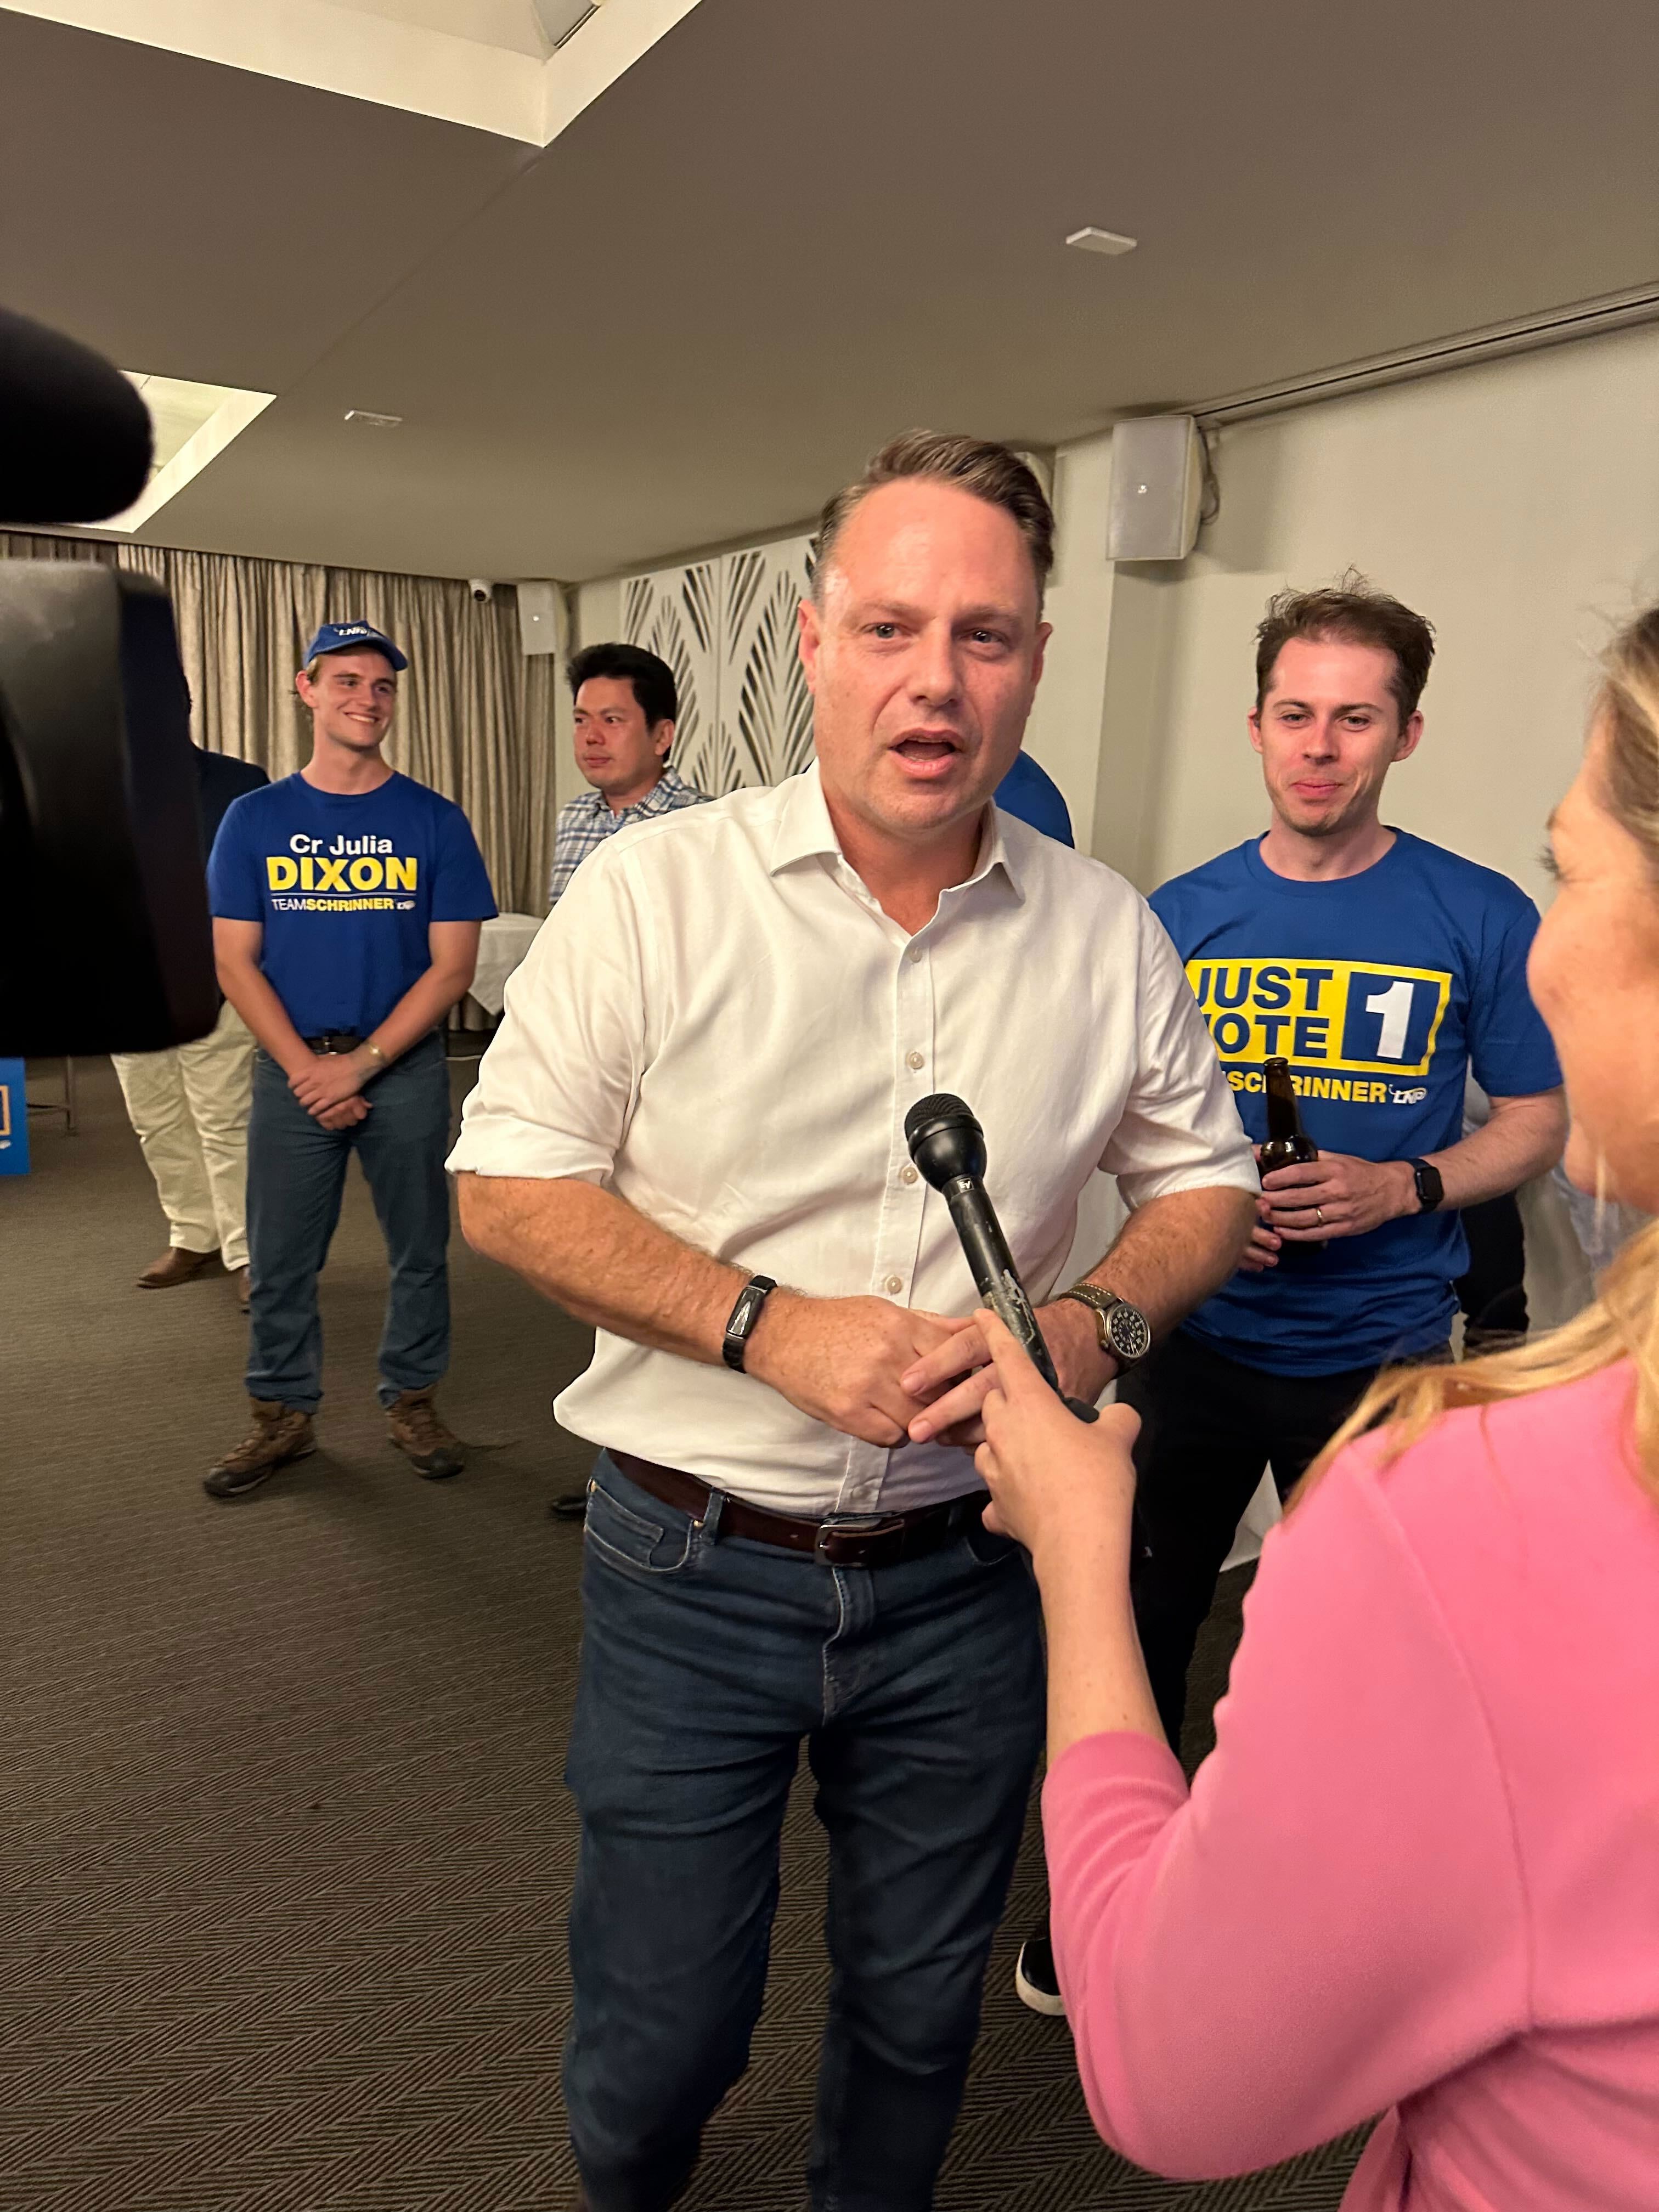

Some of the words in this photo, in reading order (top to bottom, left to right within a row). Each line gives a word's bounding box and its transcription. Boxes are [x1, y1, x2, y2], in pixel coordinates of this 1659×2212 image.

[290, 834, 323, 854] Cr
[329, 835, 393, 855] Julia
[266, 856, 417, 891] DIXON
[272, 898, 394, 911] TEAMSCHRINNER
[1365, 980, 1415, 1059] 1
